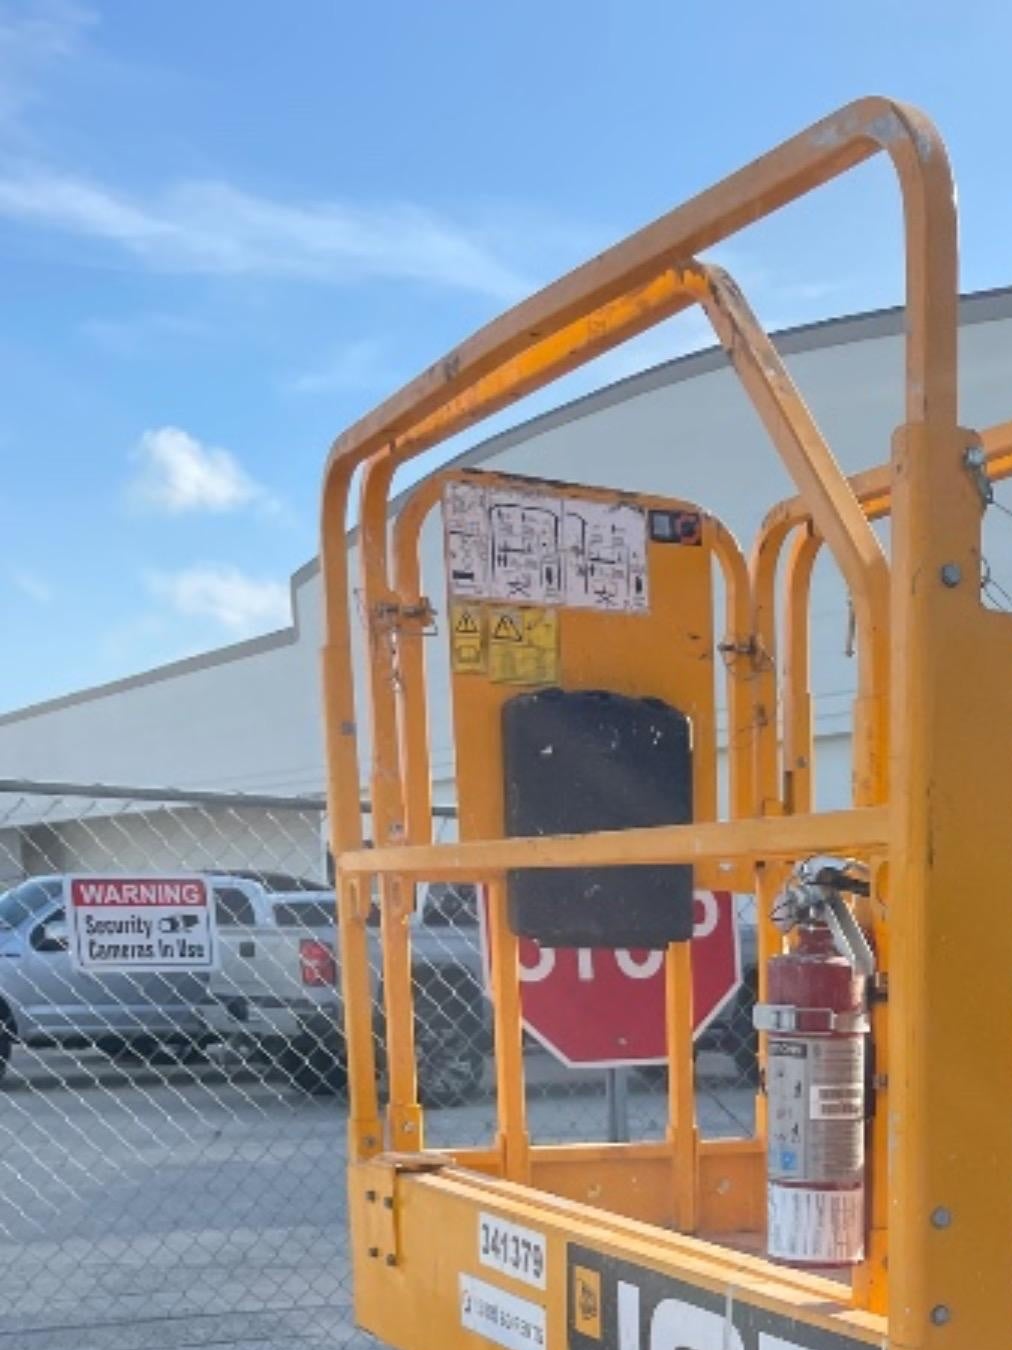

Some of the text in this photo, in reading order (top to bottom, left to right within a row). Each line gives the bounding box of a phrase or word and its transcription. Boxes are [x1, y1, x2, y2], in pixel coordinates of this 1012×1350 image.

[79, 884, 200, 904] WARNING
[85, 914, 152, 938] Security
[88, 938, 205, 960] Cameras In Use
